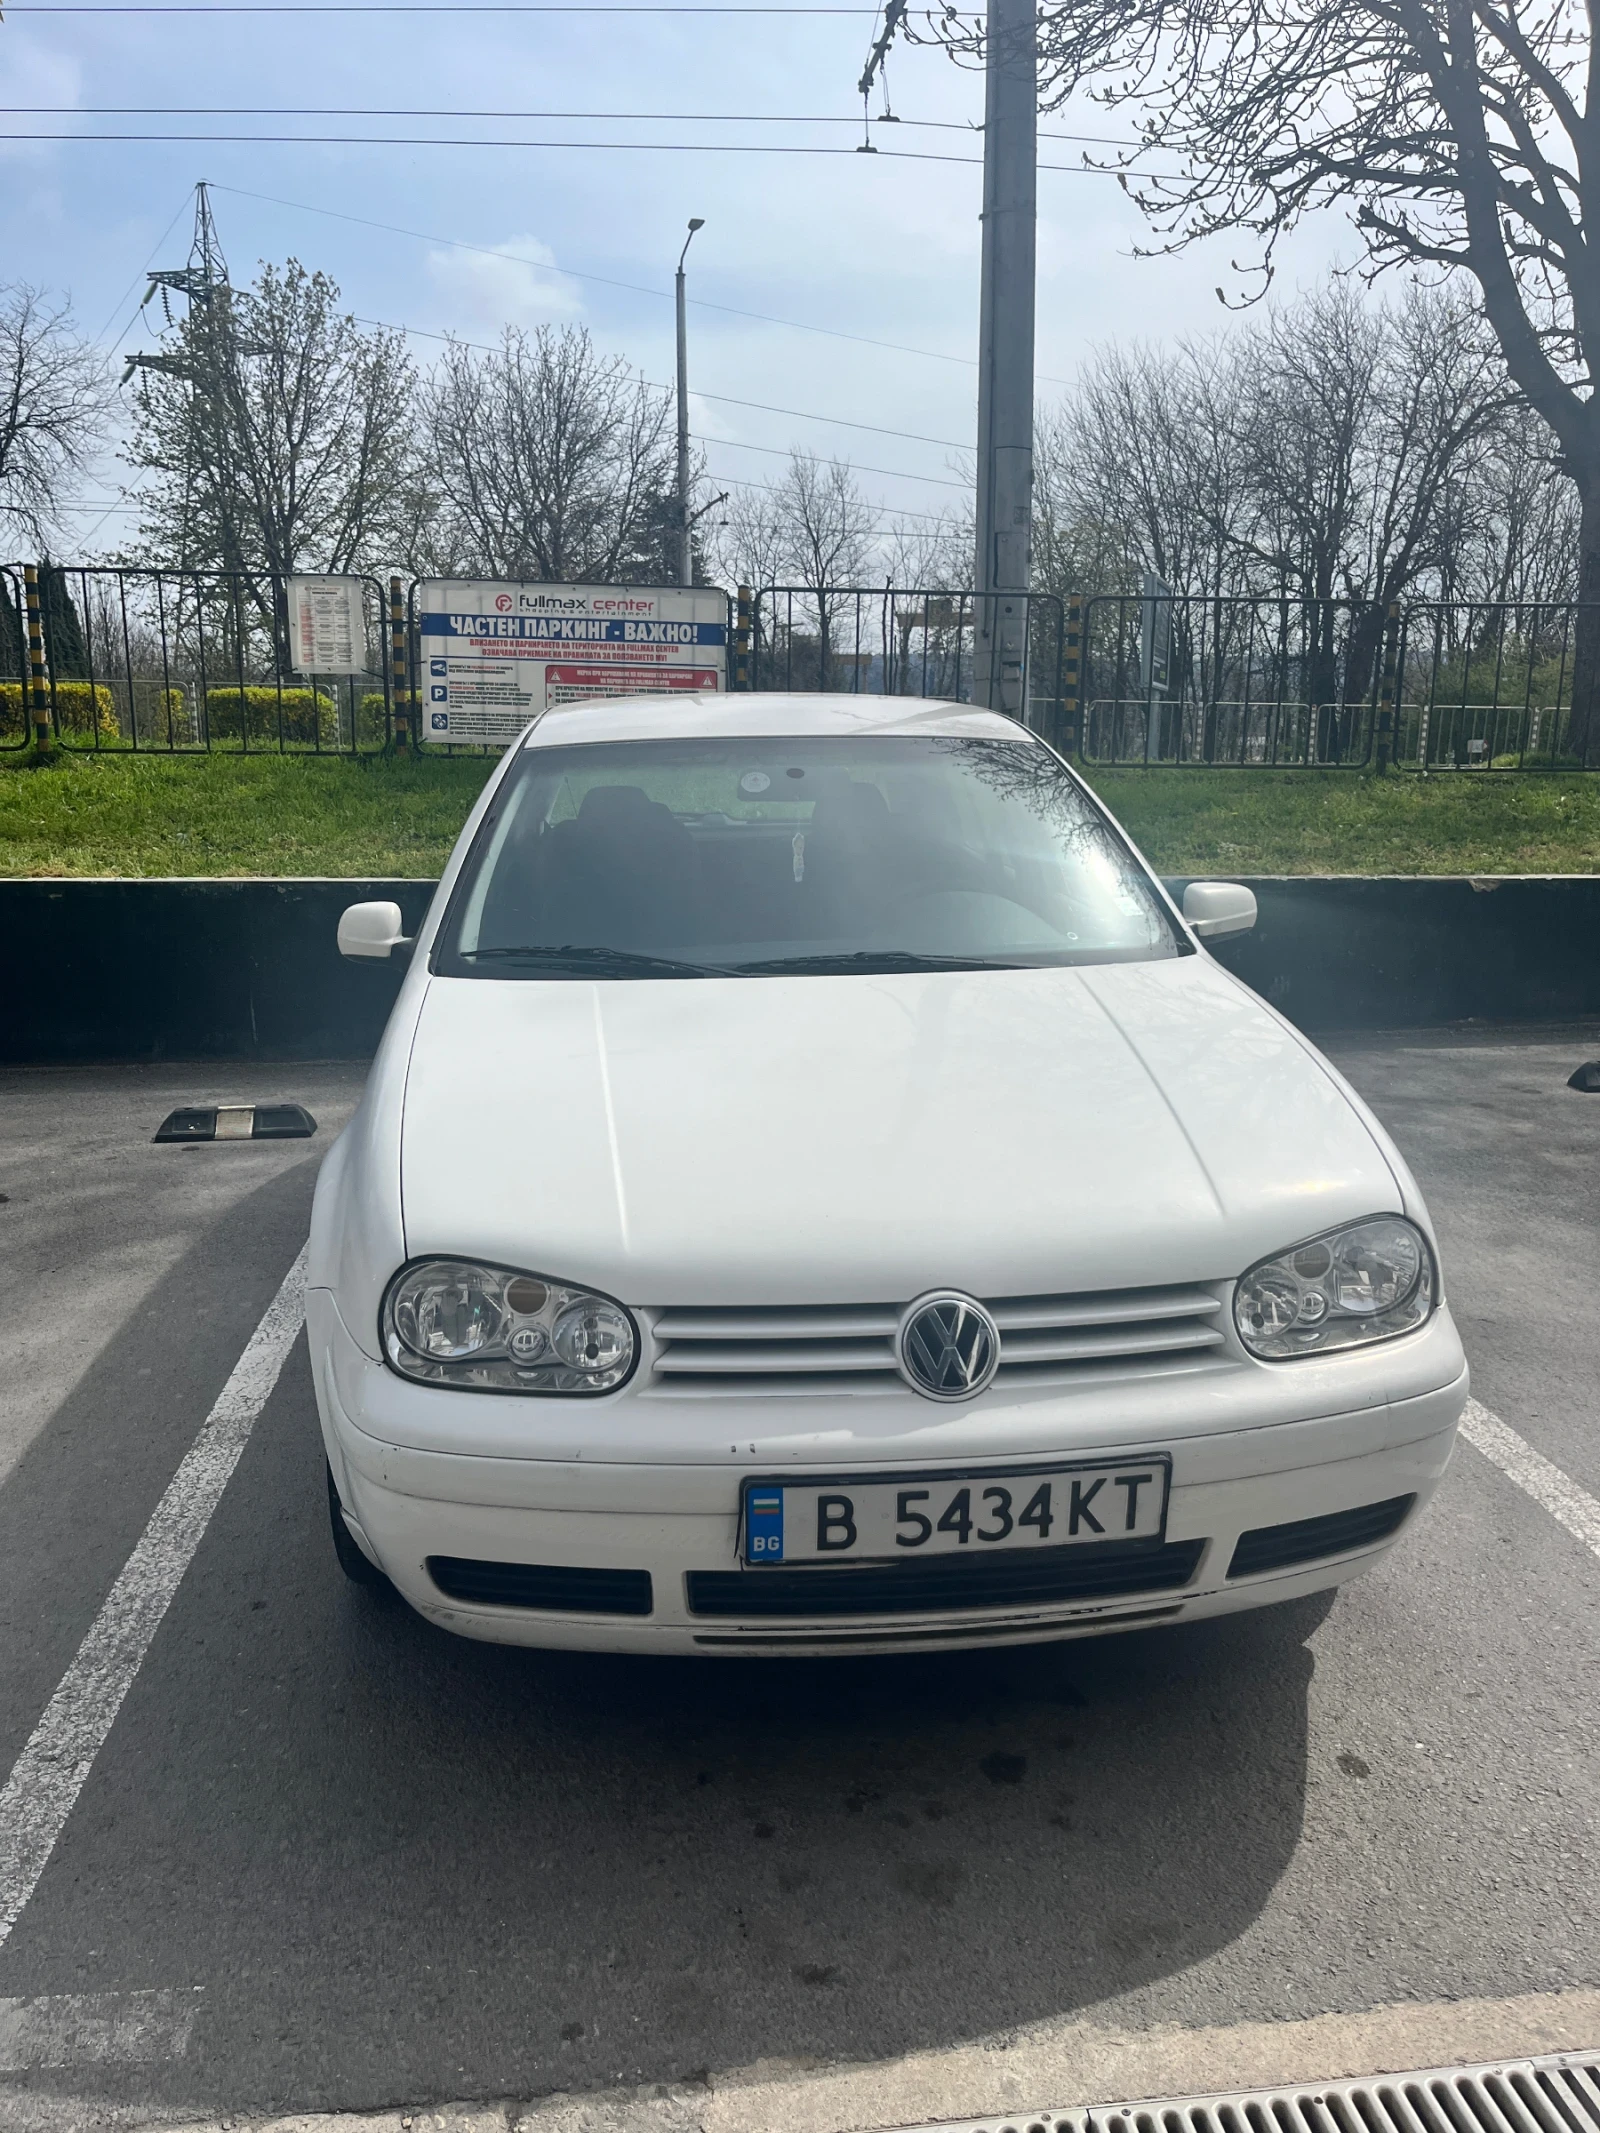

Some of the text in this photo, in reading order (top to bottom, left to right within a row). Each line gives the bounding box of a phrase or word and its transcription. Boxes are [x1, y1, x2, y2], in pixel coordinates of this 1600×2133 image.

[520, 595, 655, 611] fullmax center
[450, 616, 519, 636] ЧАСТЕН
[524, 619, 610, 639] ПАРКИНГ
[624, 622, 698, 643] ВАЖНО!
[470, 639, 508, 648] ВЛИЗАНЕТО
[572, 642, 616, 651] ТЕРИТОРИЯТА
[626, 644, 654, 652] FULLMAX
[817, 1494, 857, 1551] B
[754, 1536, 780, 1551] BG
